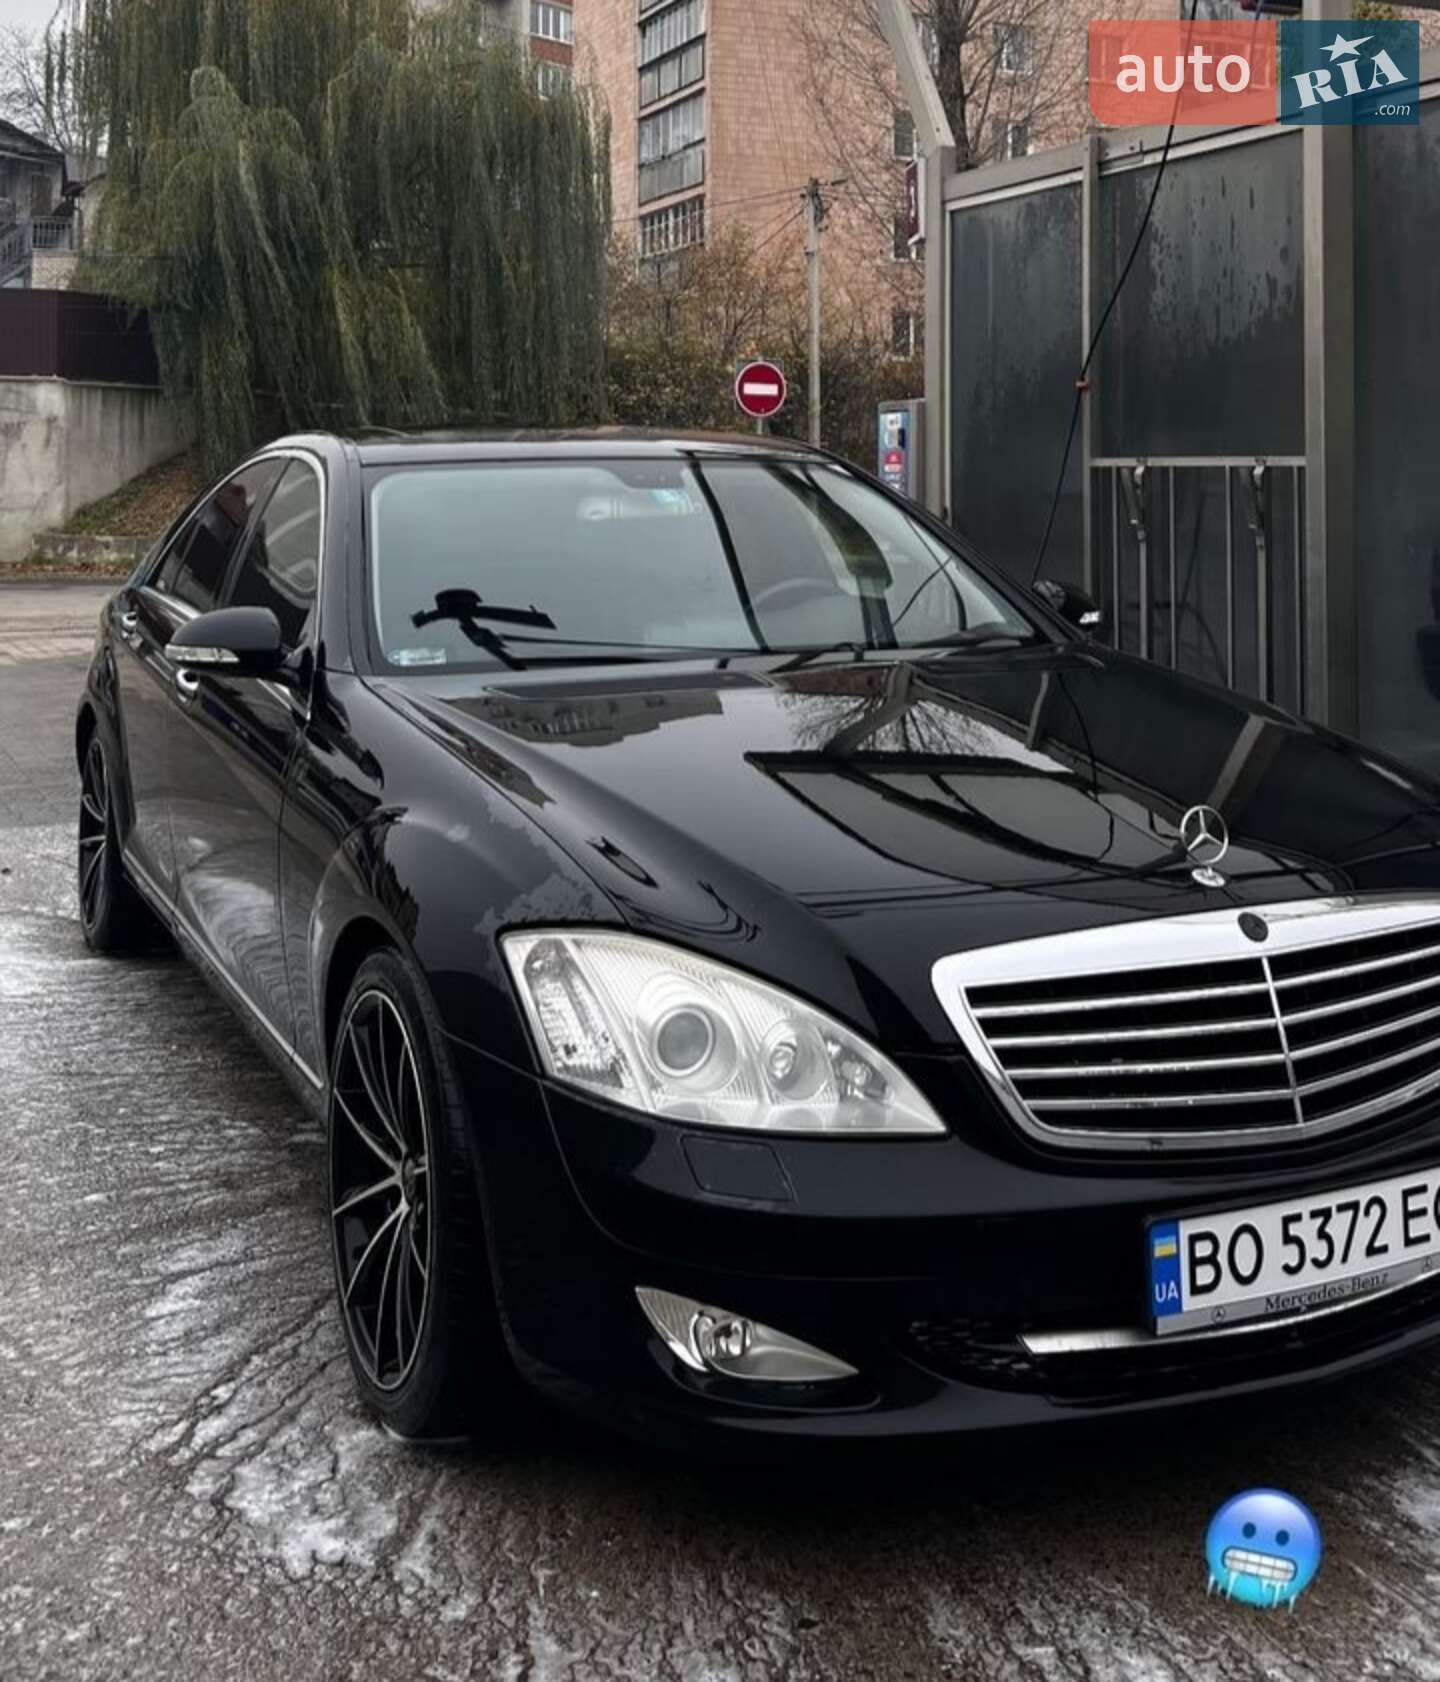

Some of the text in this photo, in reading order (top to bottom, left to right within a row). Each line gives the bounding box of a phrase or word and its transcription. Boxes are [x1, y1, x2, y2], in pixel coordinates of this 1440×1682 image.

[1187, 1183, 1440, 1297] BO 5372 E
[1155, 1280, 1180, 1303] UA
